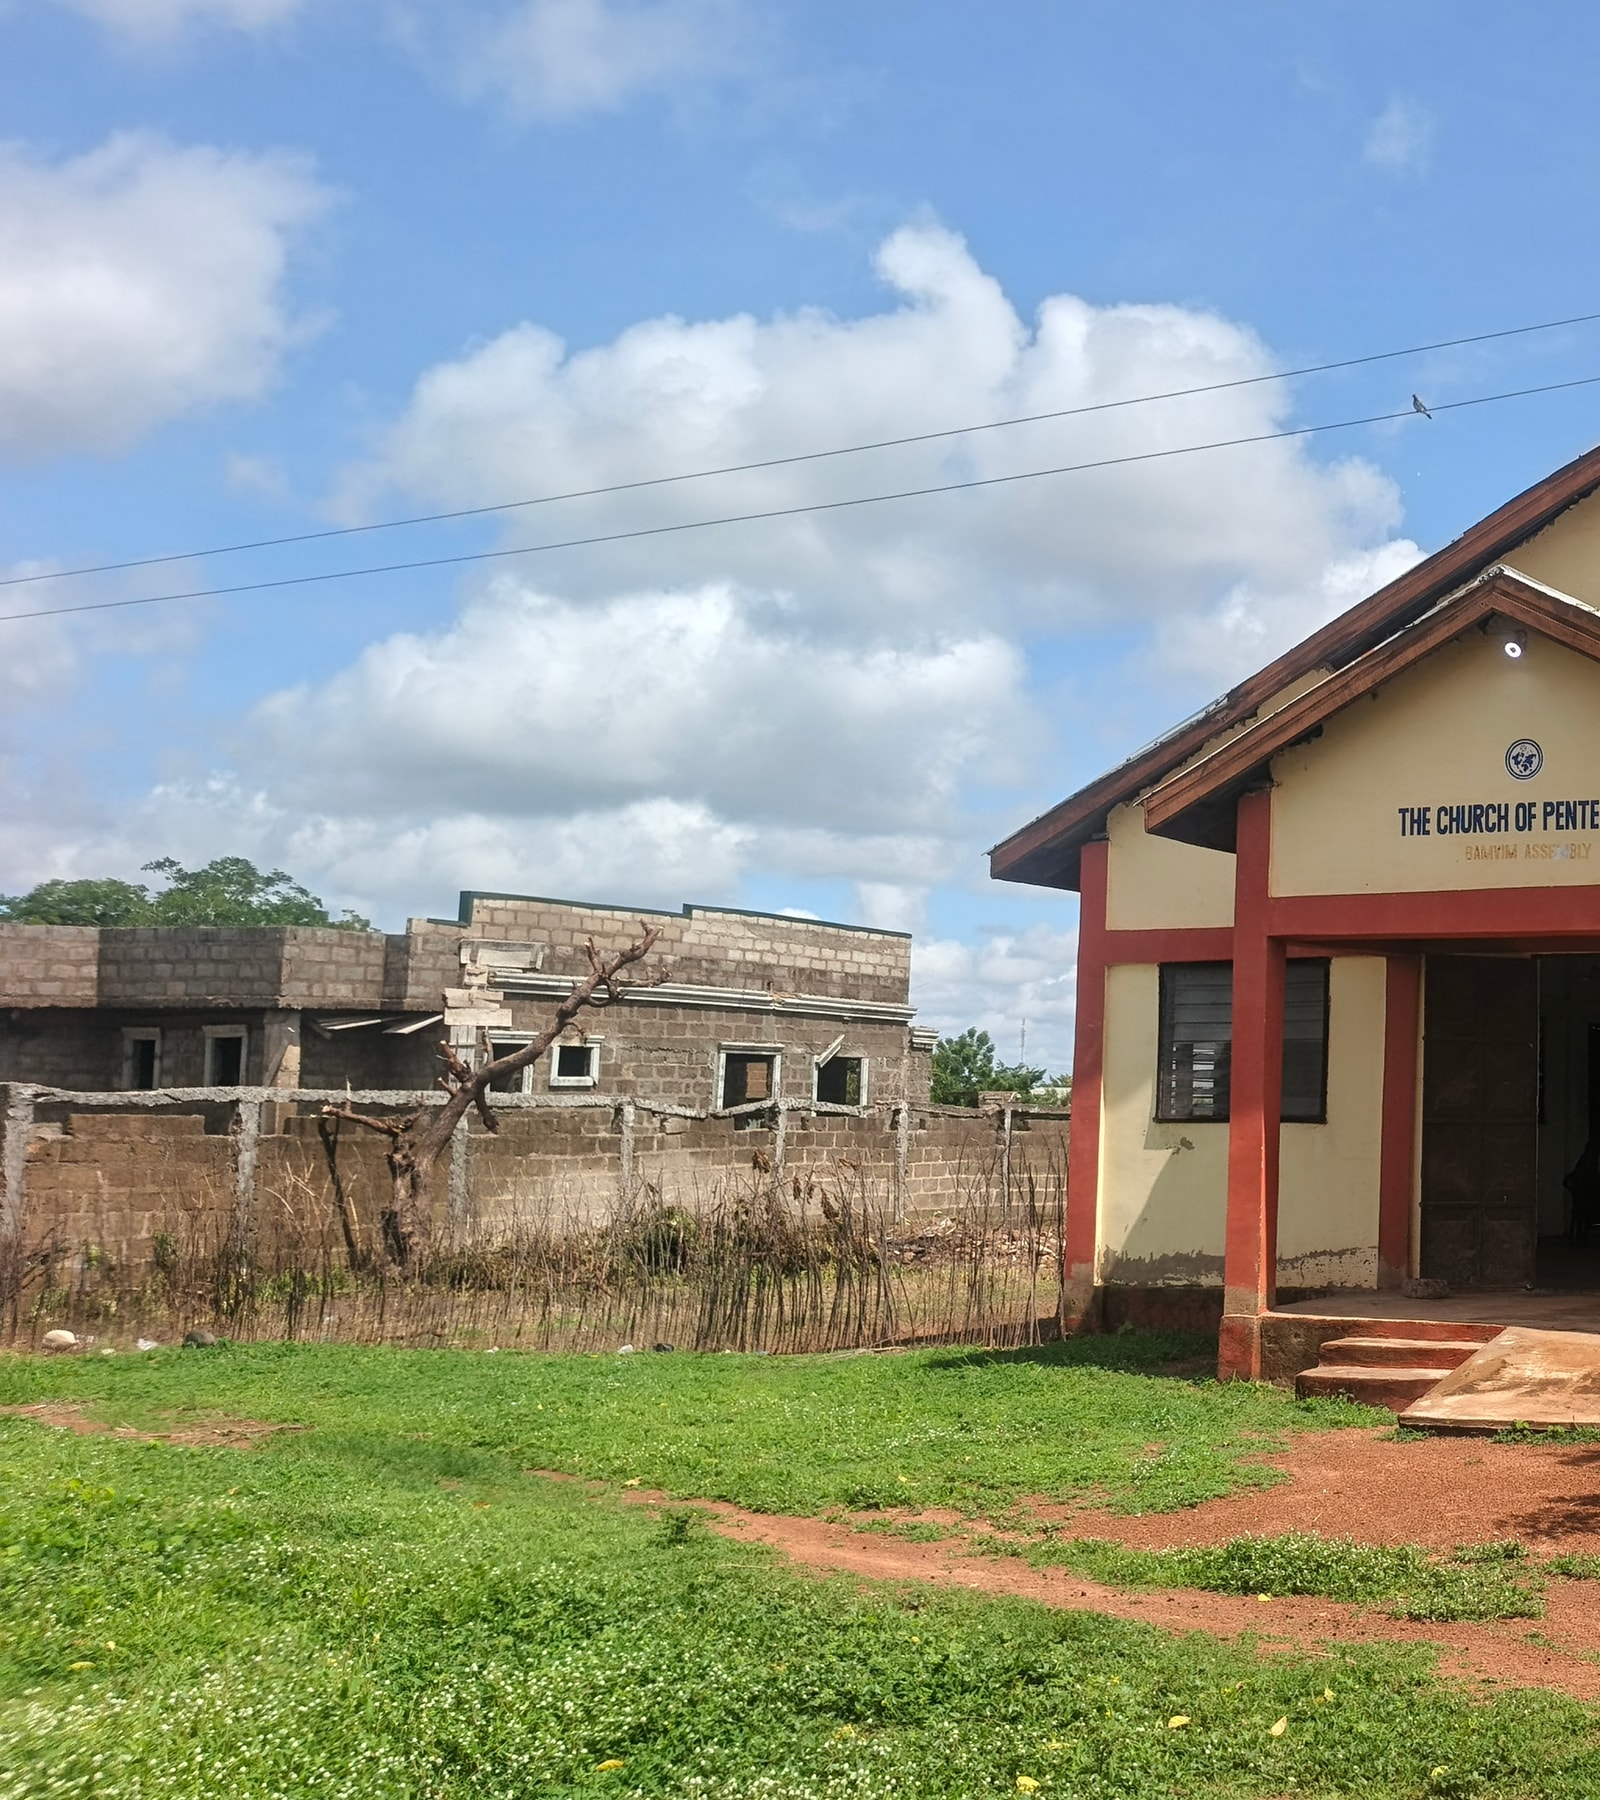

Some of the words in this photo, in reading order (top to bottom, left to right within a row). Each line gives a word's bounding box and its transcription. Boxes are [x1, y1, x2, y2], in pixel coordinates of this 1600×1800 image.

[1398, 807, 1431, 836] THE
[1437, 803, 1509, 835] CHURCH
[1515, 802, 1537, 832] OF
[1523, 843, 1592, 860] ASSEBLY
